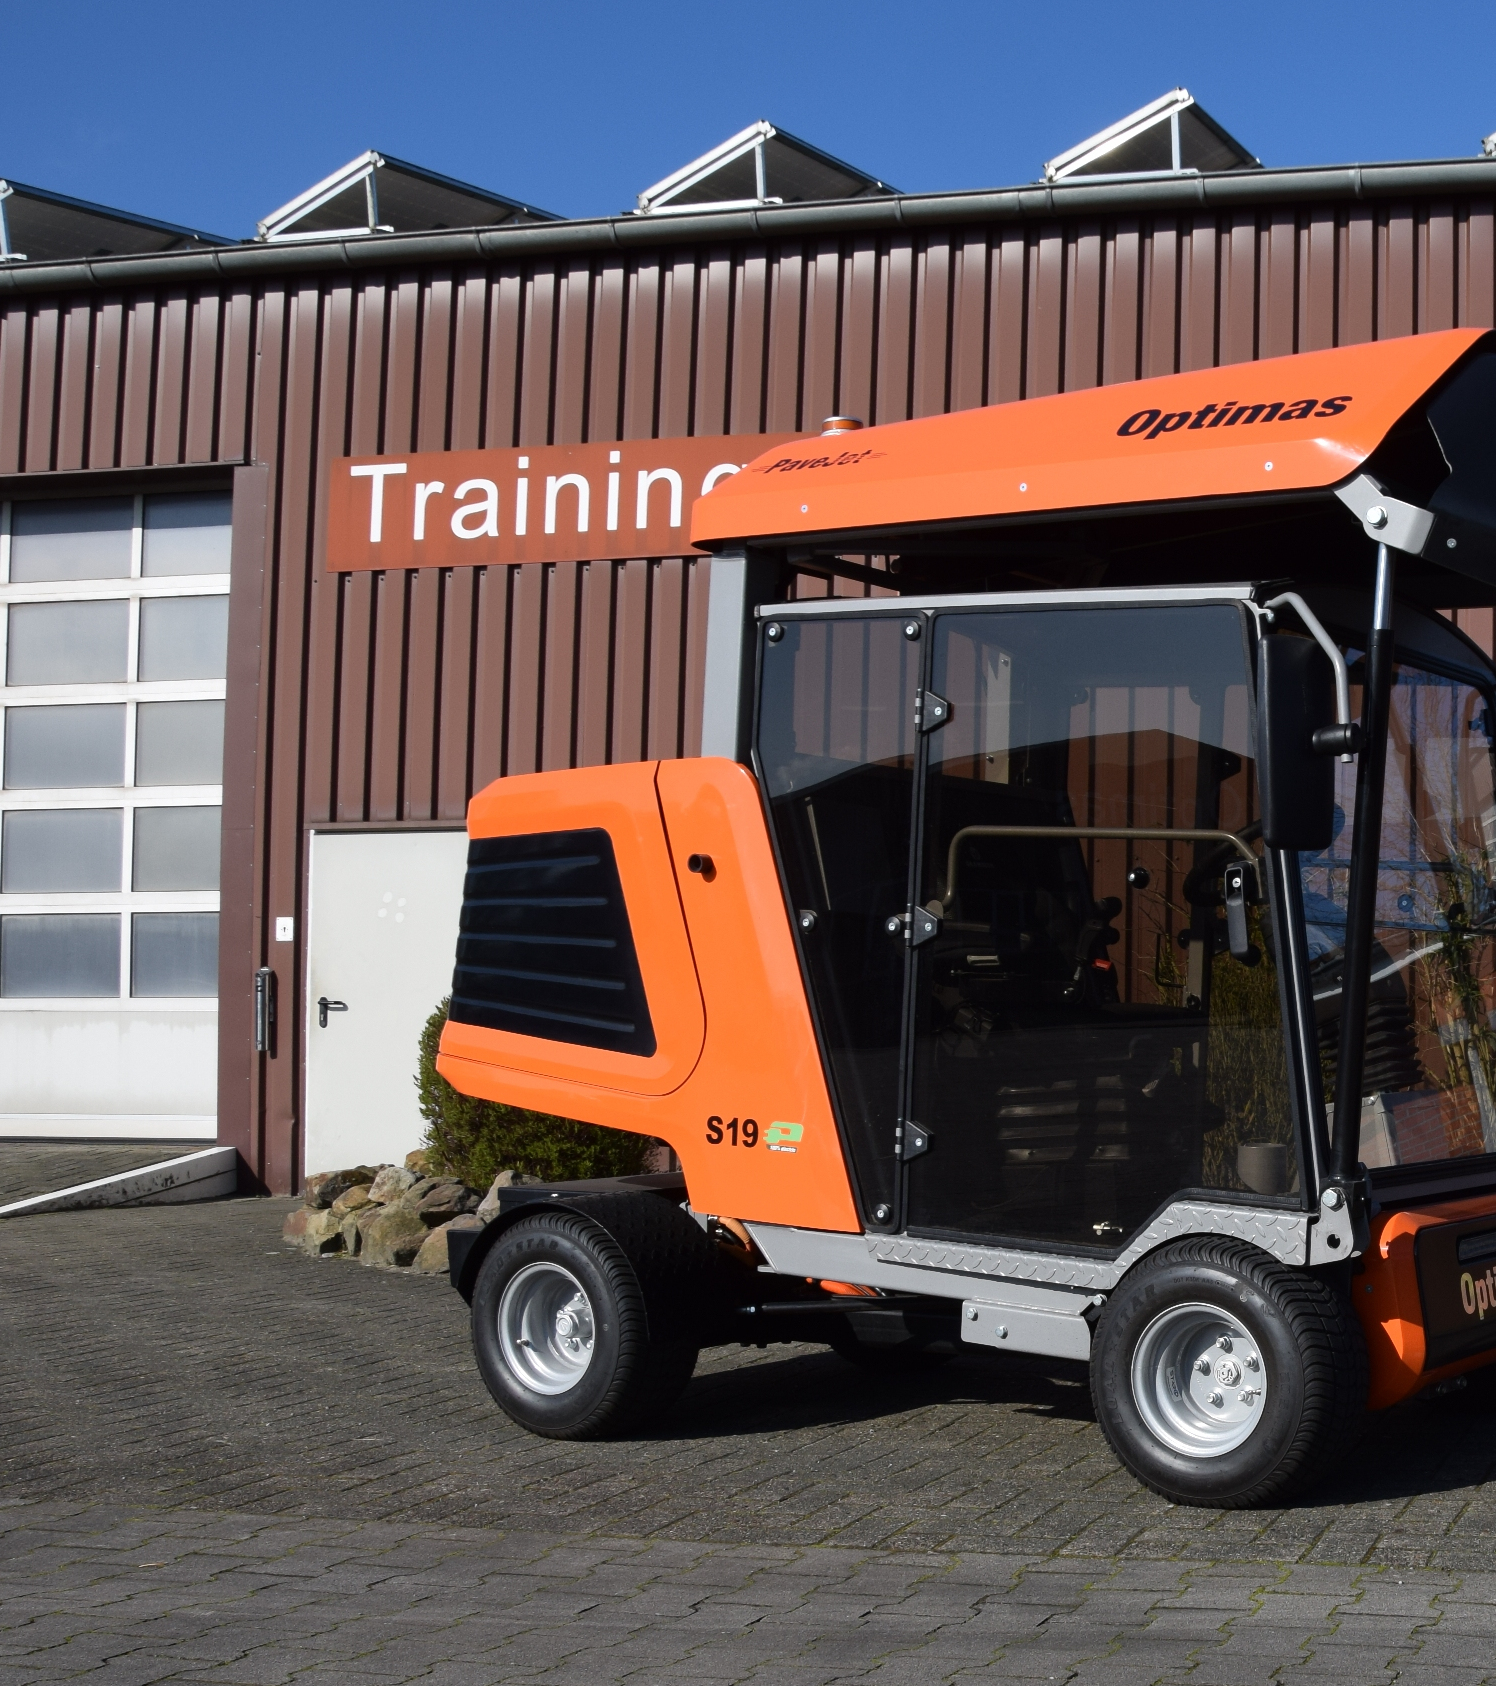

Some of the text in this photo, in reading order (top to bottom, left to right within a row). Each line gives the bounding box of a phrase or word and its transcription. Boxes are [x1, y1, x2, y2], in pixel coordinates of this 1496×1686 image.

[1116, 395, 1353, 440] Optimas
[763, 449, 873, 474] PaveJet
[350, 450, 749, 543] Trainin
[705, 1115, 759, 1148] S19
